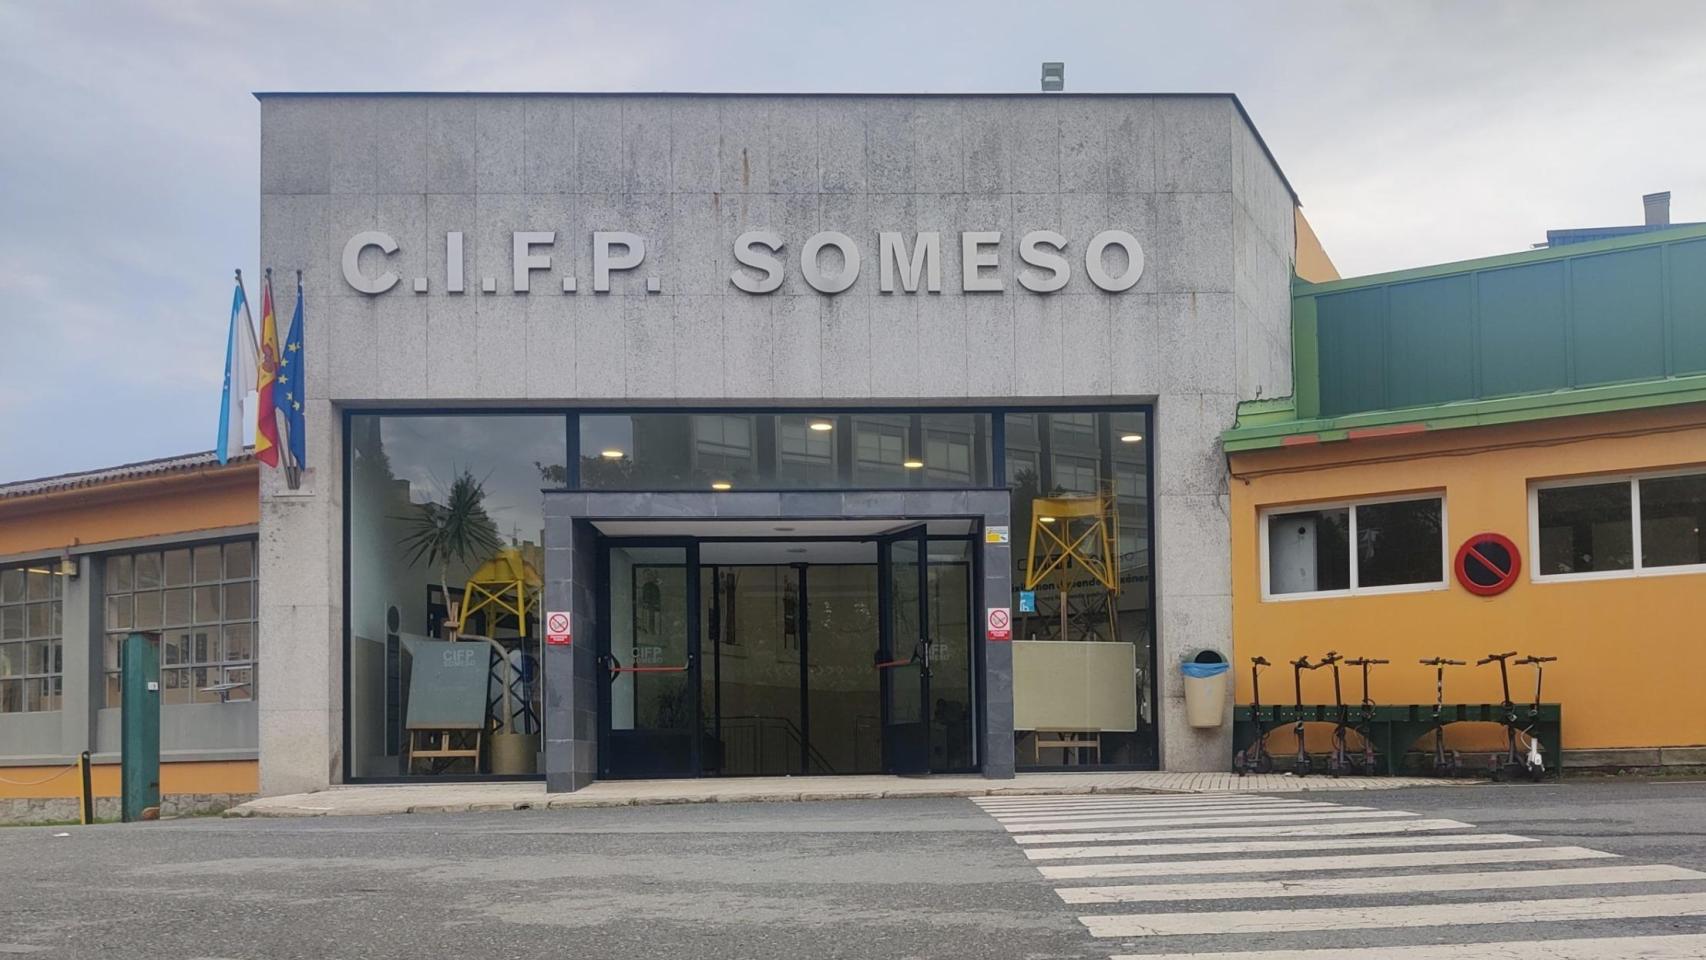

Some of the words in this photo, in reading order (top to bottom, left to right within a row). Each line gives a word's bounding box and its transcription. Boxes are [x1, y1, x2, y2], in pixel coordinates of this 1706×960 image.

[342, 230, 661, 294] C.I.F.P.
[730, 229, 1145, 293] SOMESO
[442, 649, 475, 661] CIFP
